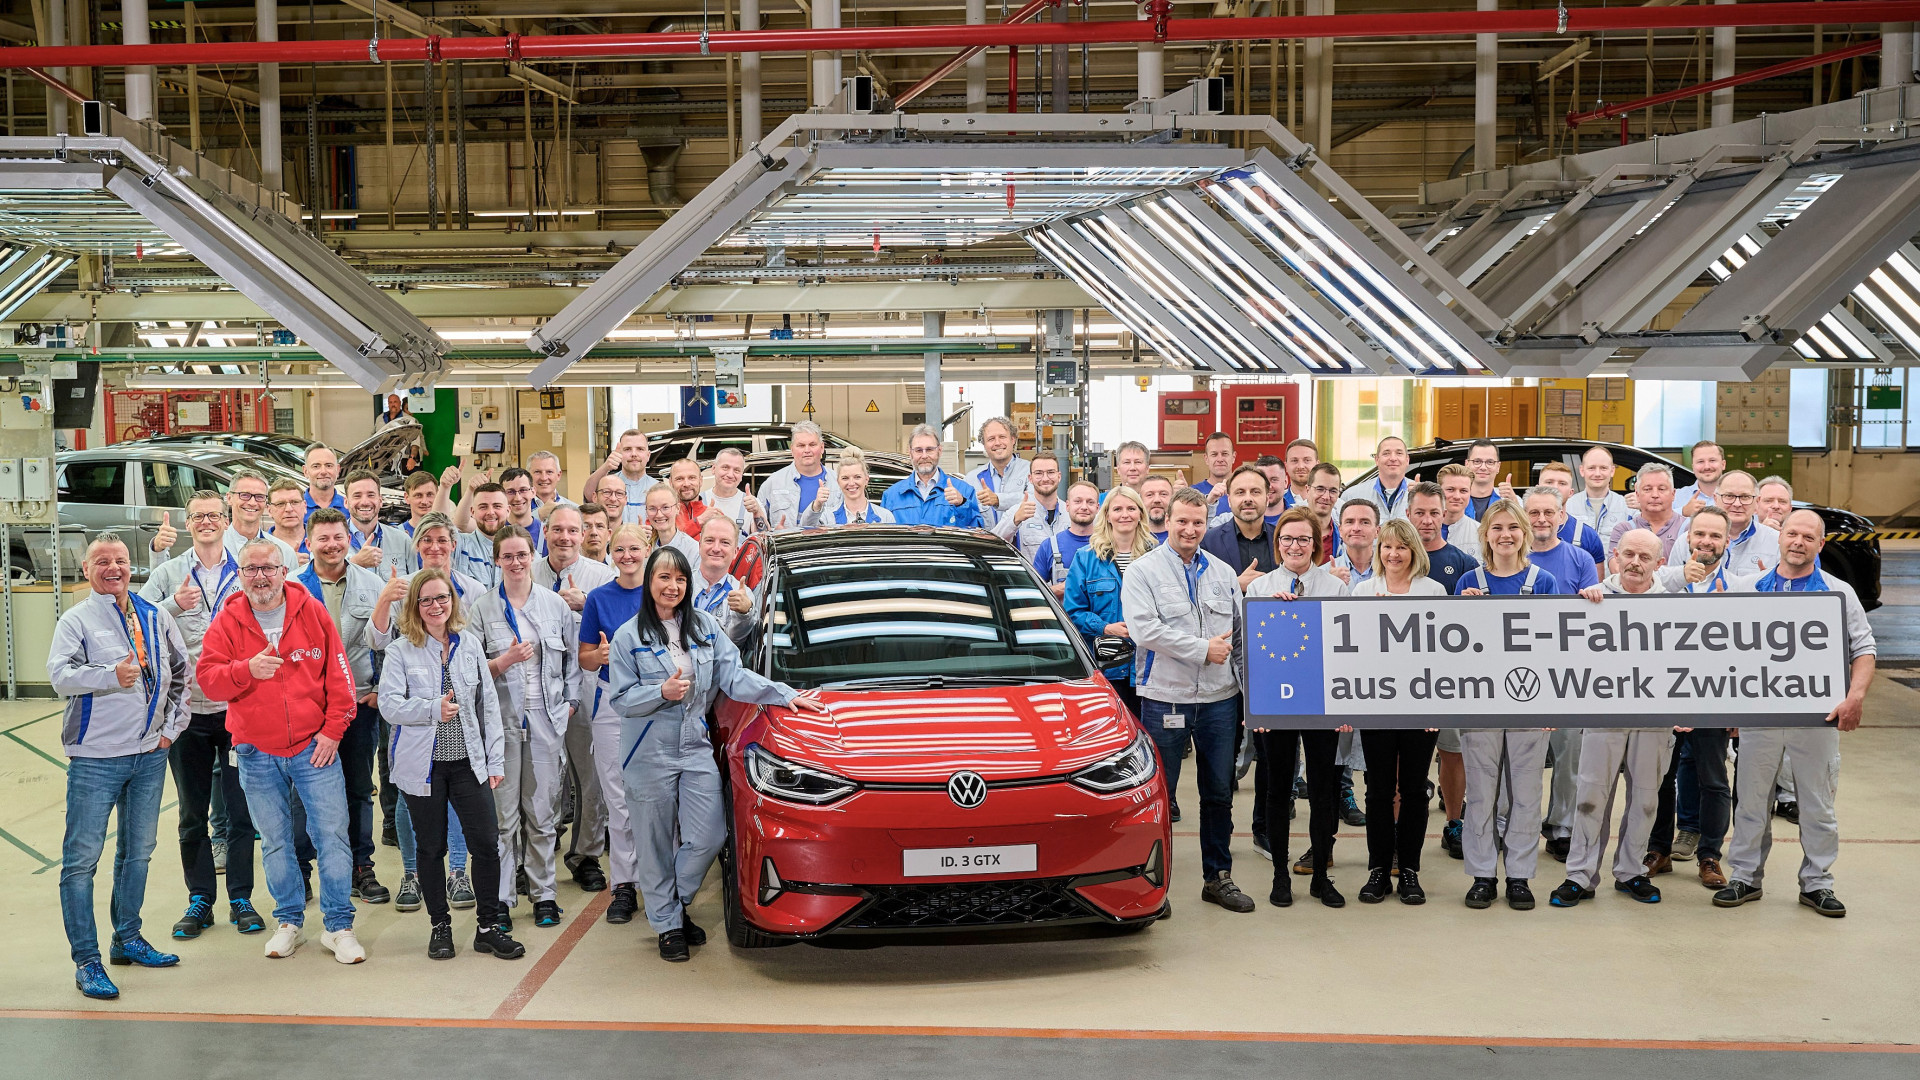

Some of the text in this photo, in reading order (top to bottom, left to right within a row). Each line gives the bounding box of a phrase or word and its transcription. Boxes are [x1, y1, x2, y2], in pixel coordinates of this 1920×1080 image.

[1333, 611, 1829, 663] 1 Mio. E-Fahrzeuge
[1280, 683, 1294, 699] D
[1330, 677, 1397, 700] aus
[1409, 667, 1495, 700] dem
[1547, 667, 1656, 699] Werk
[1666, 665, 1831, 699] Zwickau
[941, 854, 1001, 868] ID. 3 GTX
